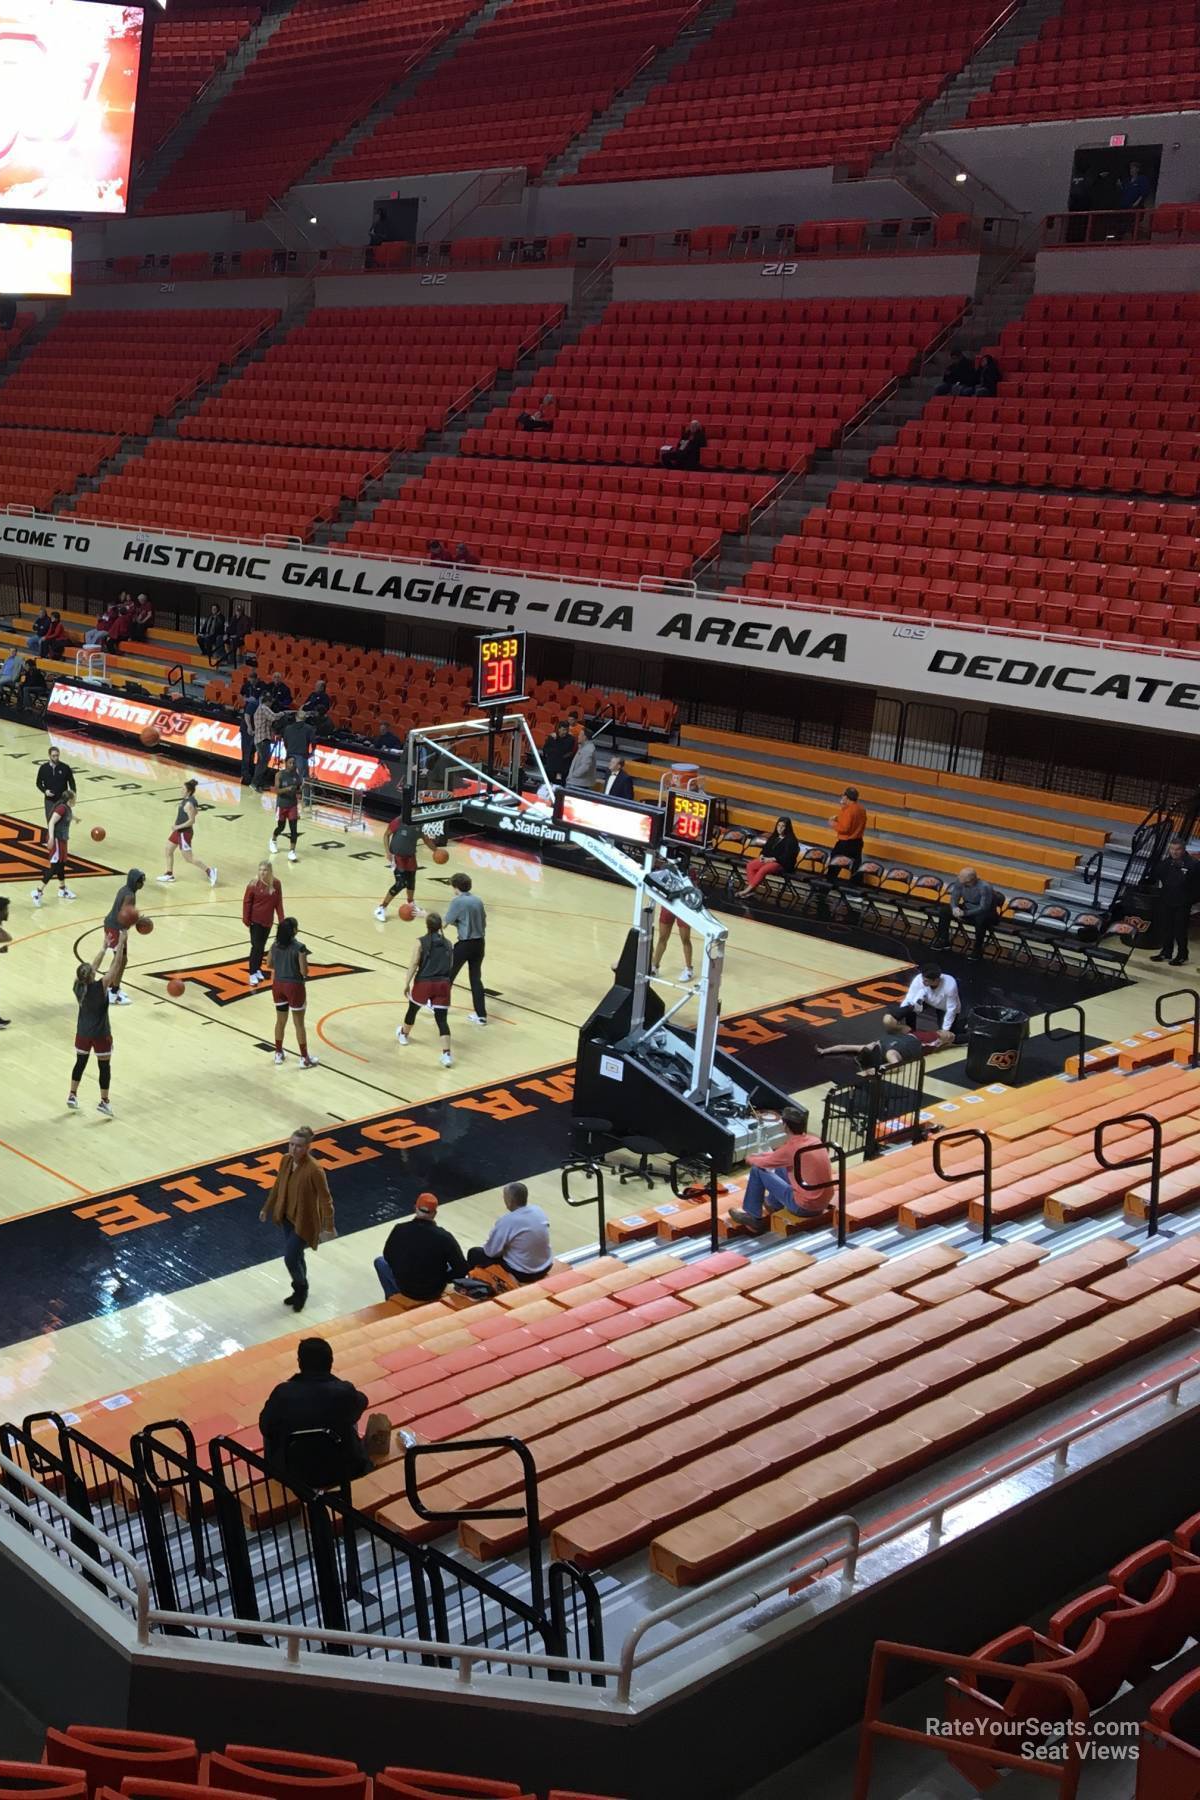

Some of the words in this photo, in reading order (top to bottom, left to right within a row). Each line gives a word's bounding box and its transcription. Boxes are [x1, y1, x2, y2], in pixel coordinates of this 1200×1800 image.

[420, 273, 447, 285] 212
[762, 263, 799, 275] 213
[63, 535, 90, 553] TO
[123, 541, 271, 580] HISTORIC
[656, 612, 848, 662] ARENA
[482, 639, 518, 661] 59:33
[486, 659, 513, 694] 30
[927, 649, 1200, 711] DEDICATE
[674, 797, 707, 818] 59:33
[677, 816, 700, 837] 30
[279, 831, 457, 886] AREA
[71, 1117, 441, 1237] STATE
